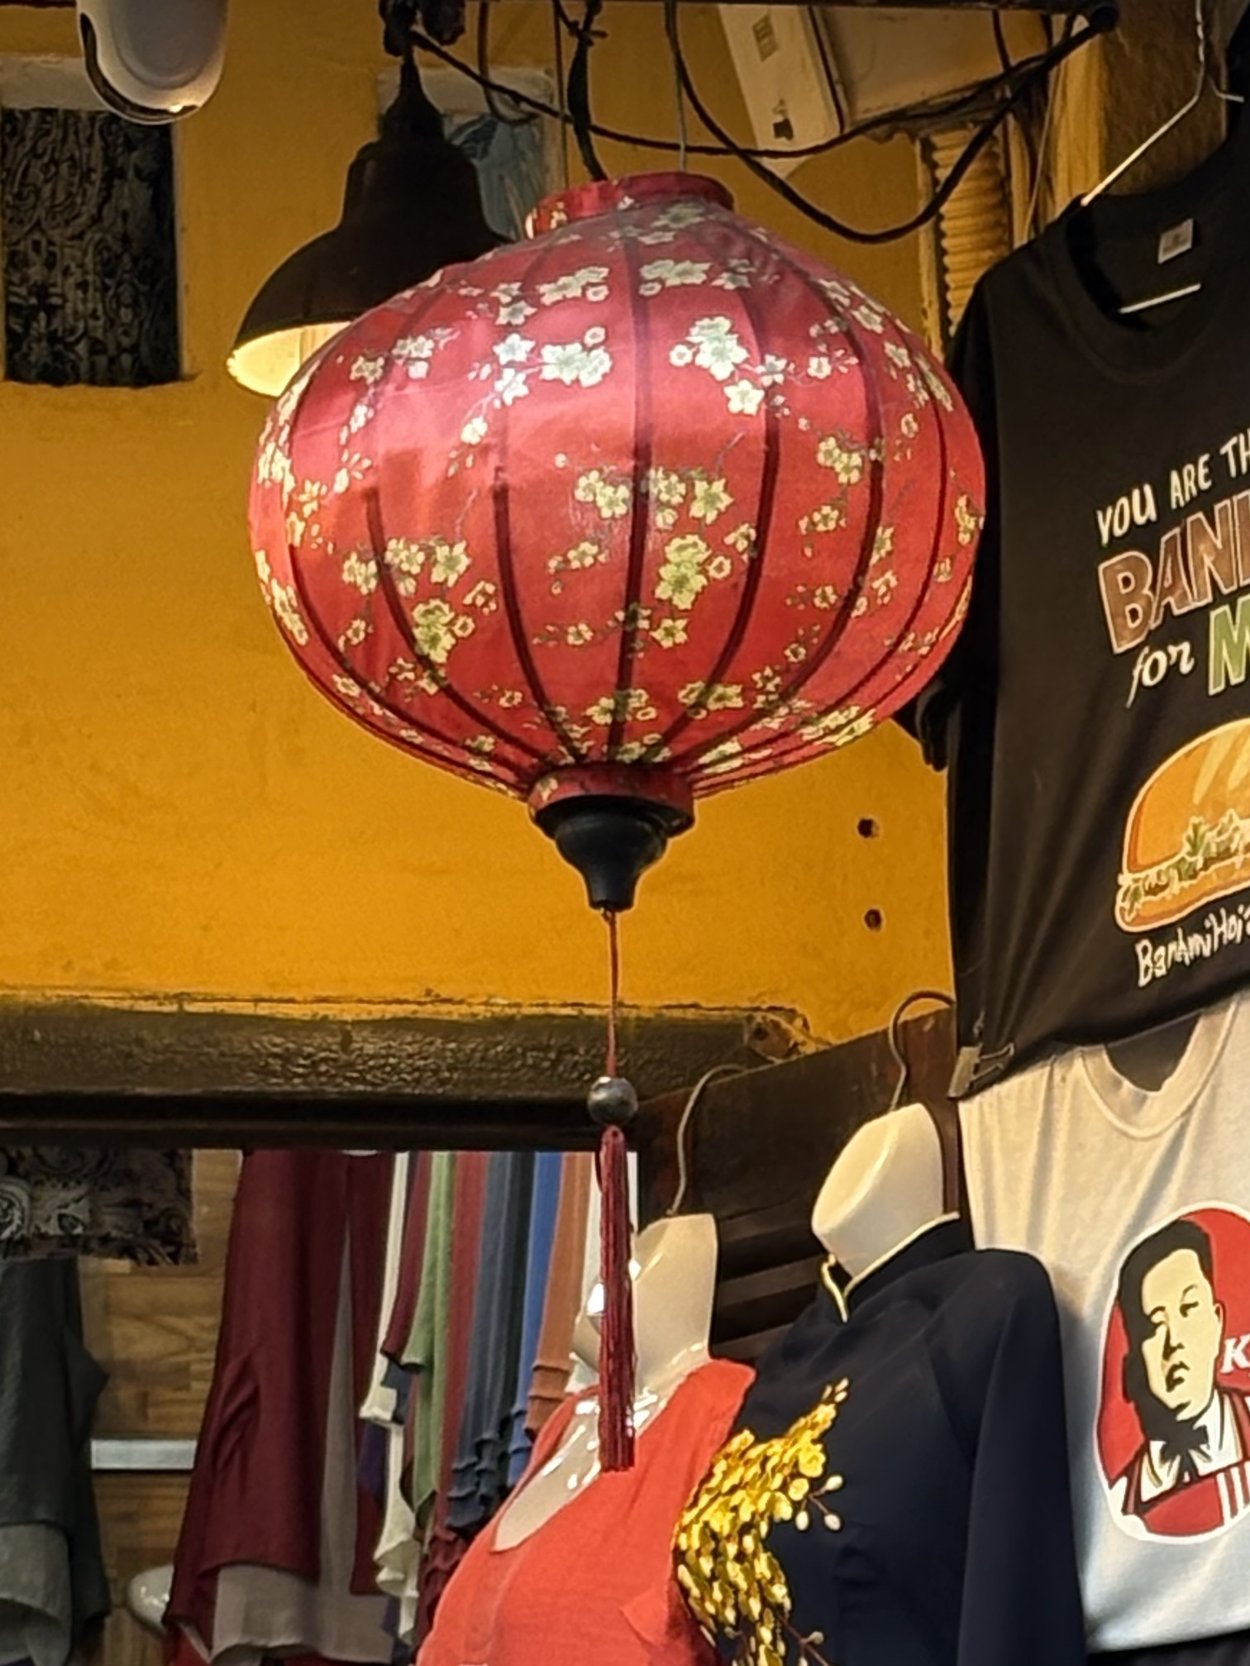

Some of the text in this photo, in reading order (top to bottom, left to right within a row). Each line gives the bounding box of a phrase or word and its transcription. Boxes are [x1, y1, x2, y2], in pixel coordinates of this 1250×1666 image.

[1097, 484, 1157, 547] YOU
[1170, 453, 1212, 509] ARE
[1126, 641, 1195, 709] for
